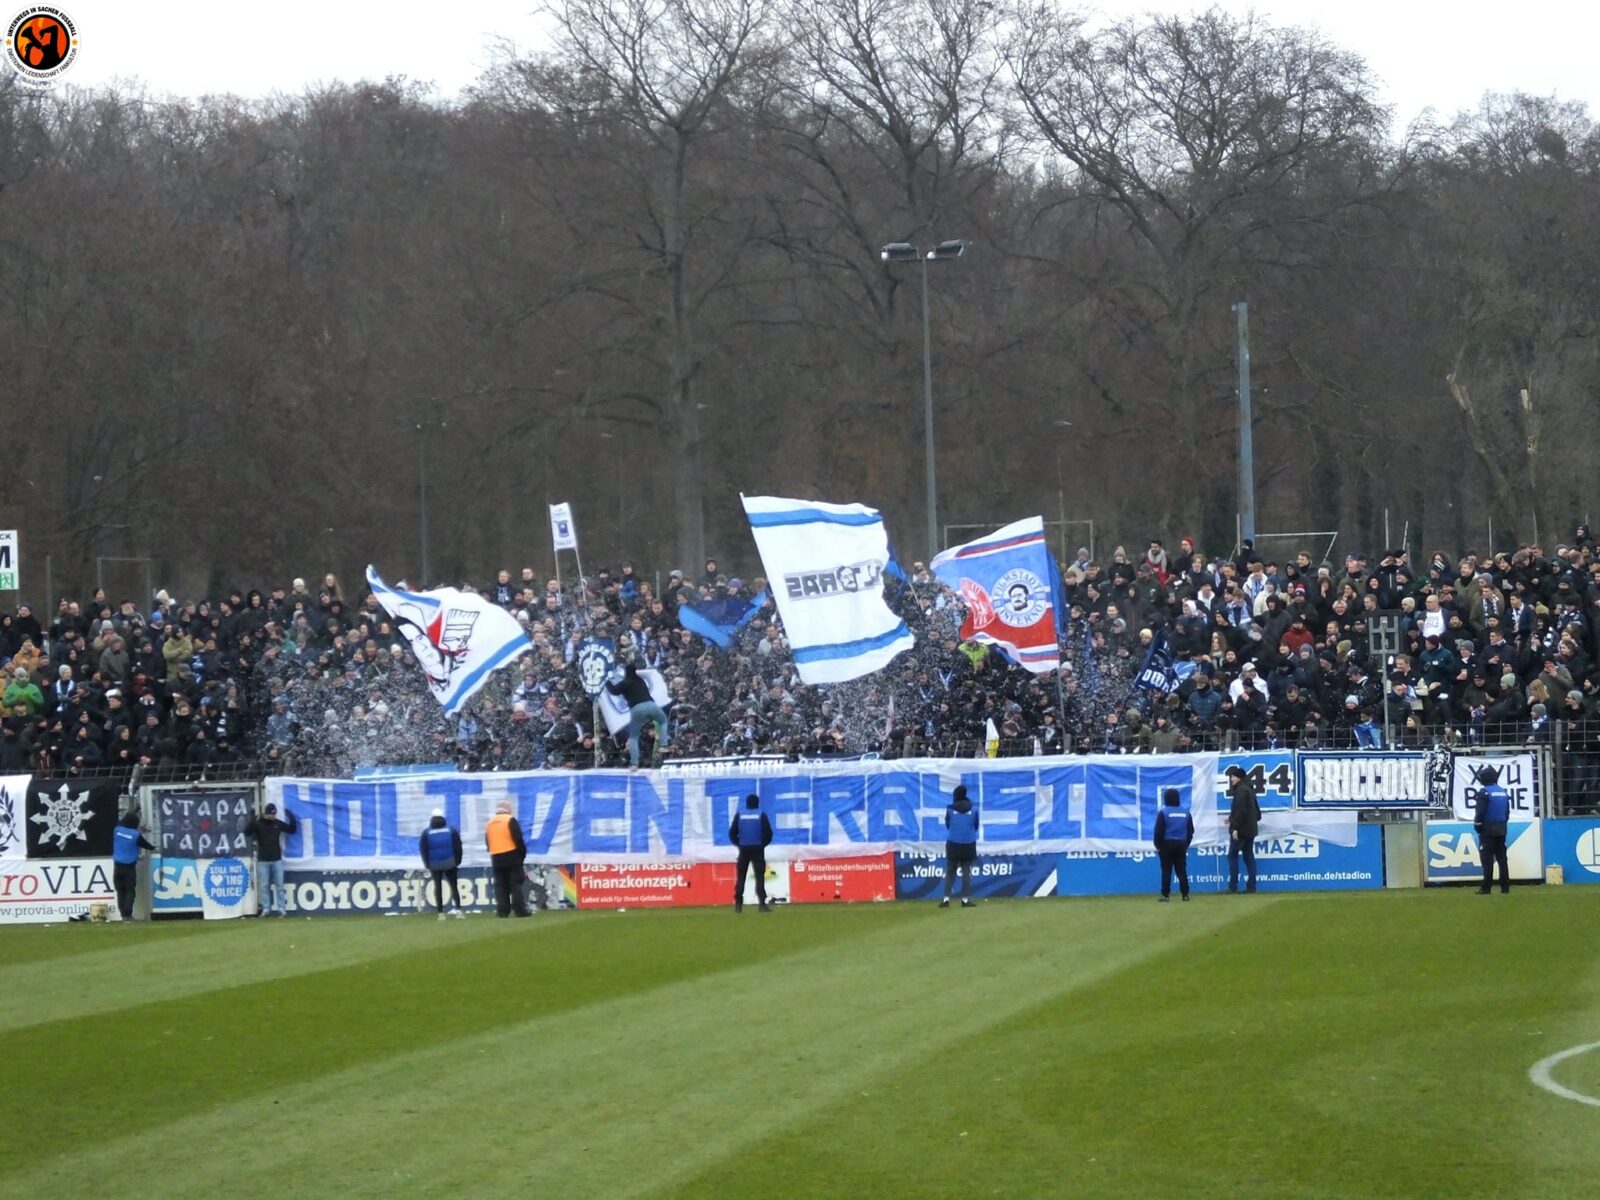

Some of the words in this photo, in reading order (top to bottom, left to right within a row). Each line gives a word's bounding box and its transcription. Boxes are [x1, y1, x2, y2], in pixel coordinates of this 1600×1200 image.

[1304, 758, 1427, 801] BRICCONI
[1428, 832, 1481, 868] SA
[807, 863, 890, 872] Mittelbrandenburgische
[982, 863, 1013, 875] SVB!
[0, 865, 114, 896] roVIA
[581, 875, 688, 890] Finanzkonzept.
[807, 873, 843, 882] Sparkasse
[1196, 874, 1224, 883] testen
[271, 877, 497, 911] HOMOPHOBI
